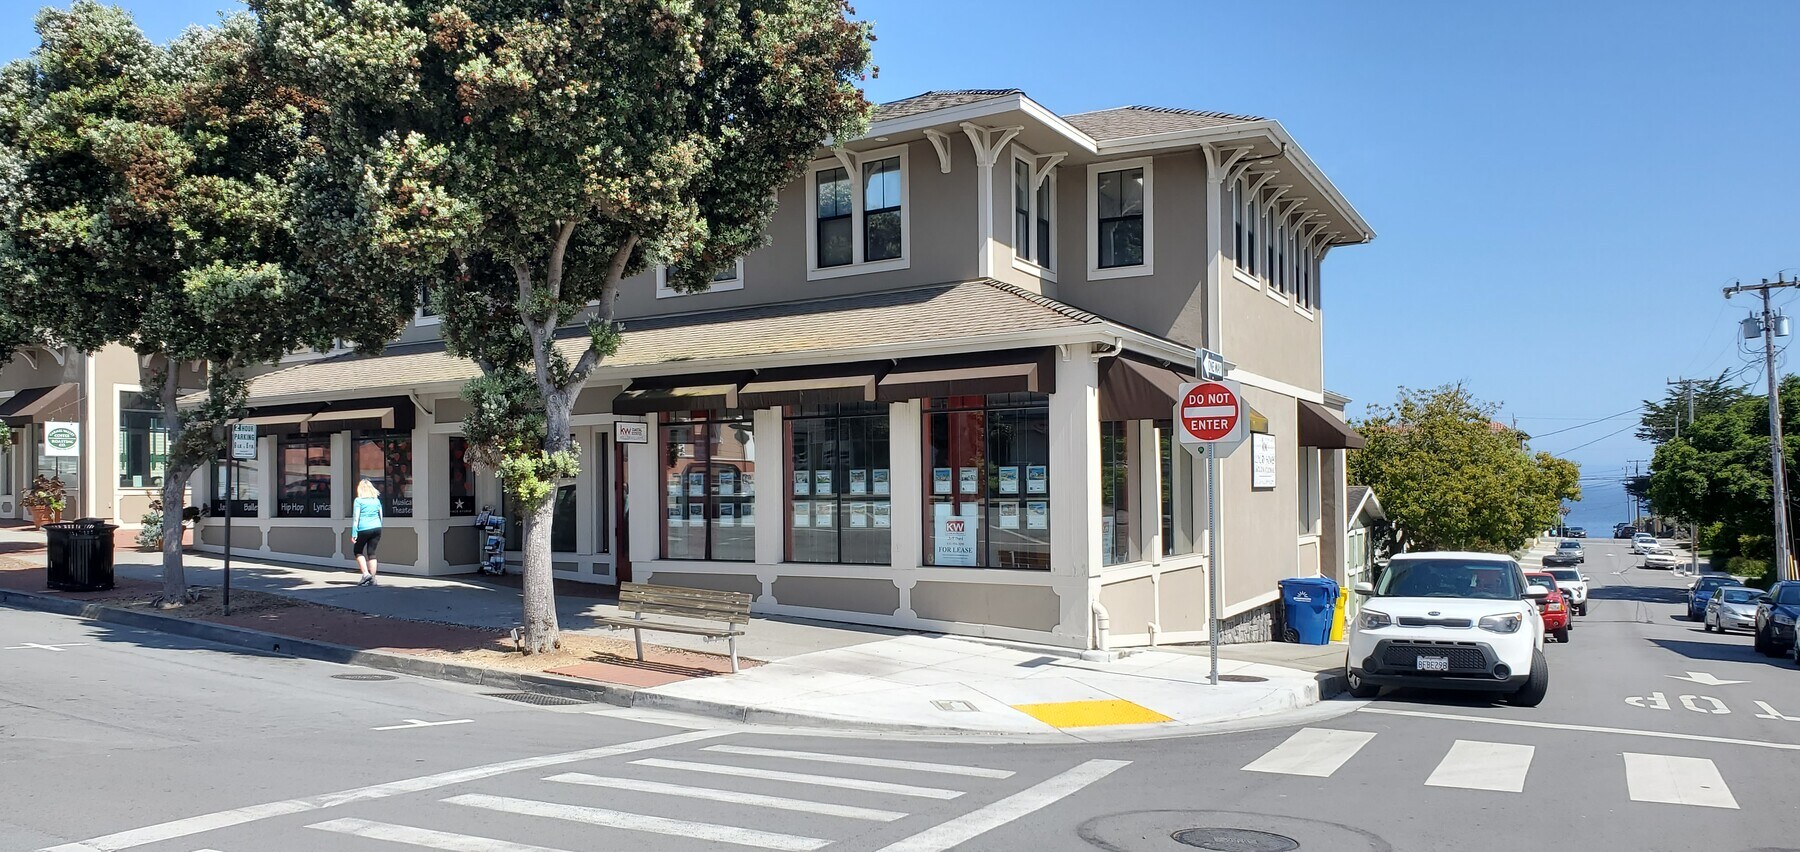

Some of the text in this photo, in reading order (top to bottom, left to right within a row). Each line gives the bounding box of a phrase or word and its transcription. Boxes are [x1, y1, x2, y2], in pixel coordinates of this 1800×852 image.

[1189, 393, 1230, 404] DO NOT
[1191, 419, 1228, 430] ENTER
[243, 503, 258, 511] Balle
[281, 503, 304, 514] Hip Hop
[313, 503, 331, 513] Lyrica
[946, 522, 964, 532] KW
[953, 546, 973, 554] LEASE
